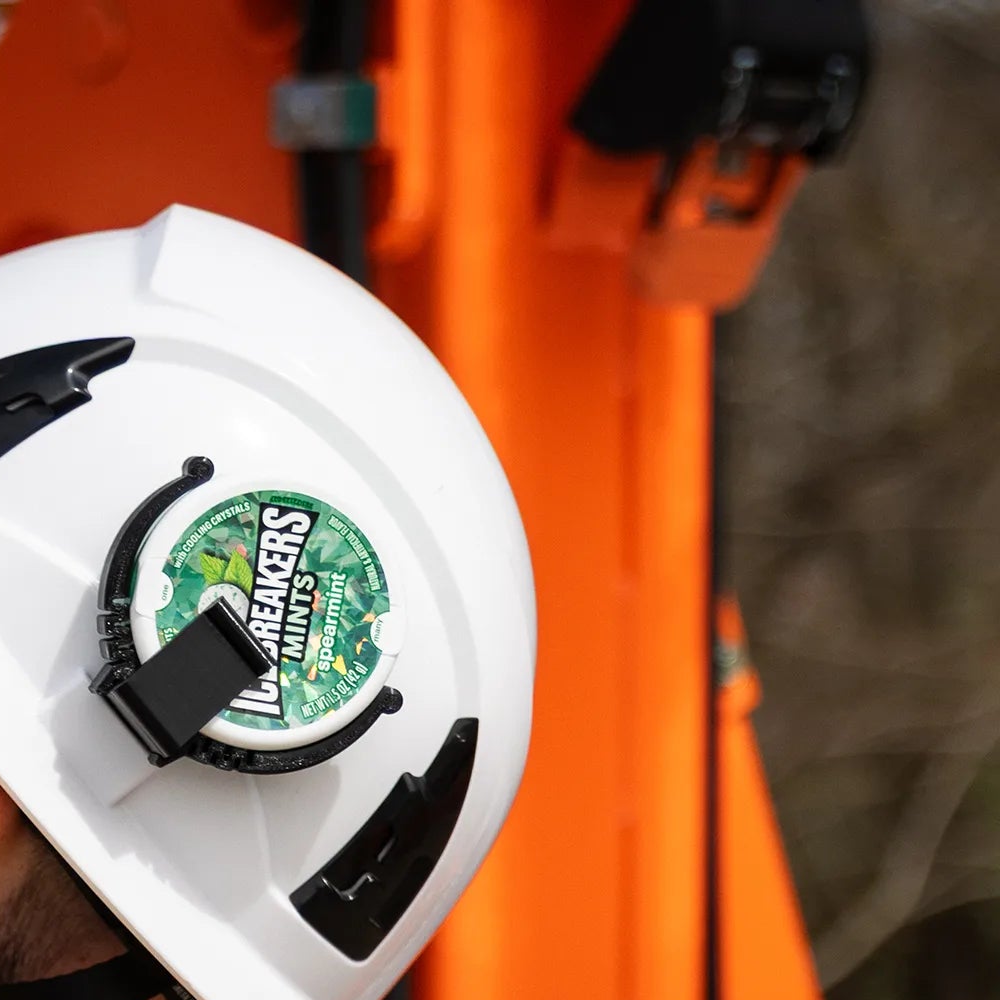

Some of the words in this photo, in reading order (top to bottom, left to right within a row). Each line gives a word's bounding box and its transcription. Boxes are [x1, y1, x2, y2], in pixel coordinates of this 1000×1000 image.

[173, 550, 186, 569] with
[182, 521, 212, 551] COOLING
[210, 501, 251, 526] CRYSTALS
[327, 515, 349, 536] FLAVOR
[344, 529, 371, 560] ARTIFICIAL
[161, 584, 170, 601] one
[364, 563, 381, 592] NATURAL
[281, 574, 315, 659] MINTS
[317, 572, 347, 672] spearmint
[373, 619, 384, 643] many
[229, 665, 281, 715] IC
[300, 701, 318, 718] NET
[314, 694, 330, 712] WT
[326, 687, 341, 704] 1.5
[336, 680, 351, 695] OZ
[344, 669, 360, 688] (42
[353, 661, 369, 675] g)
